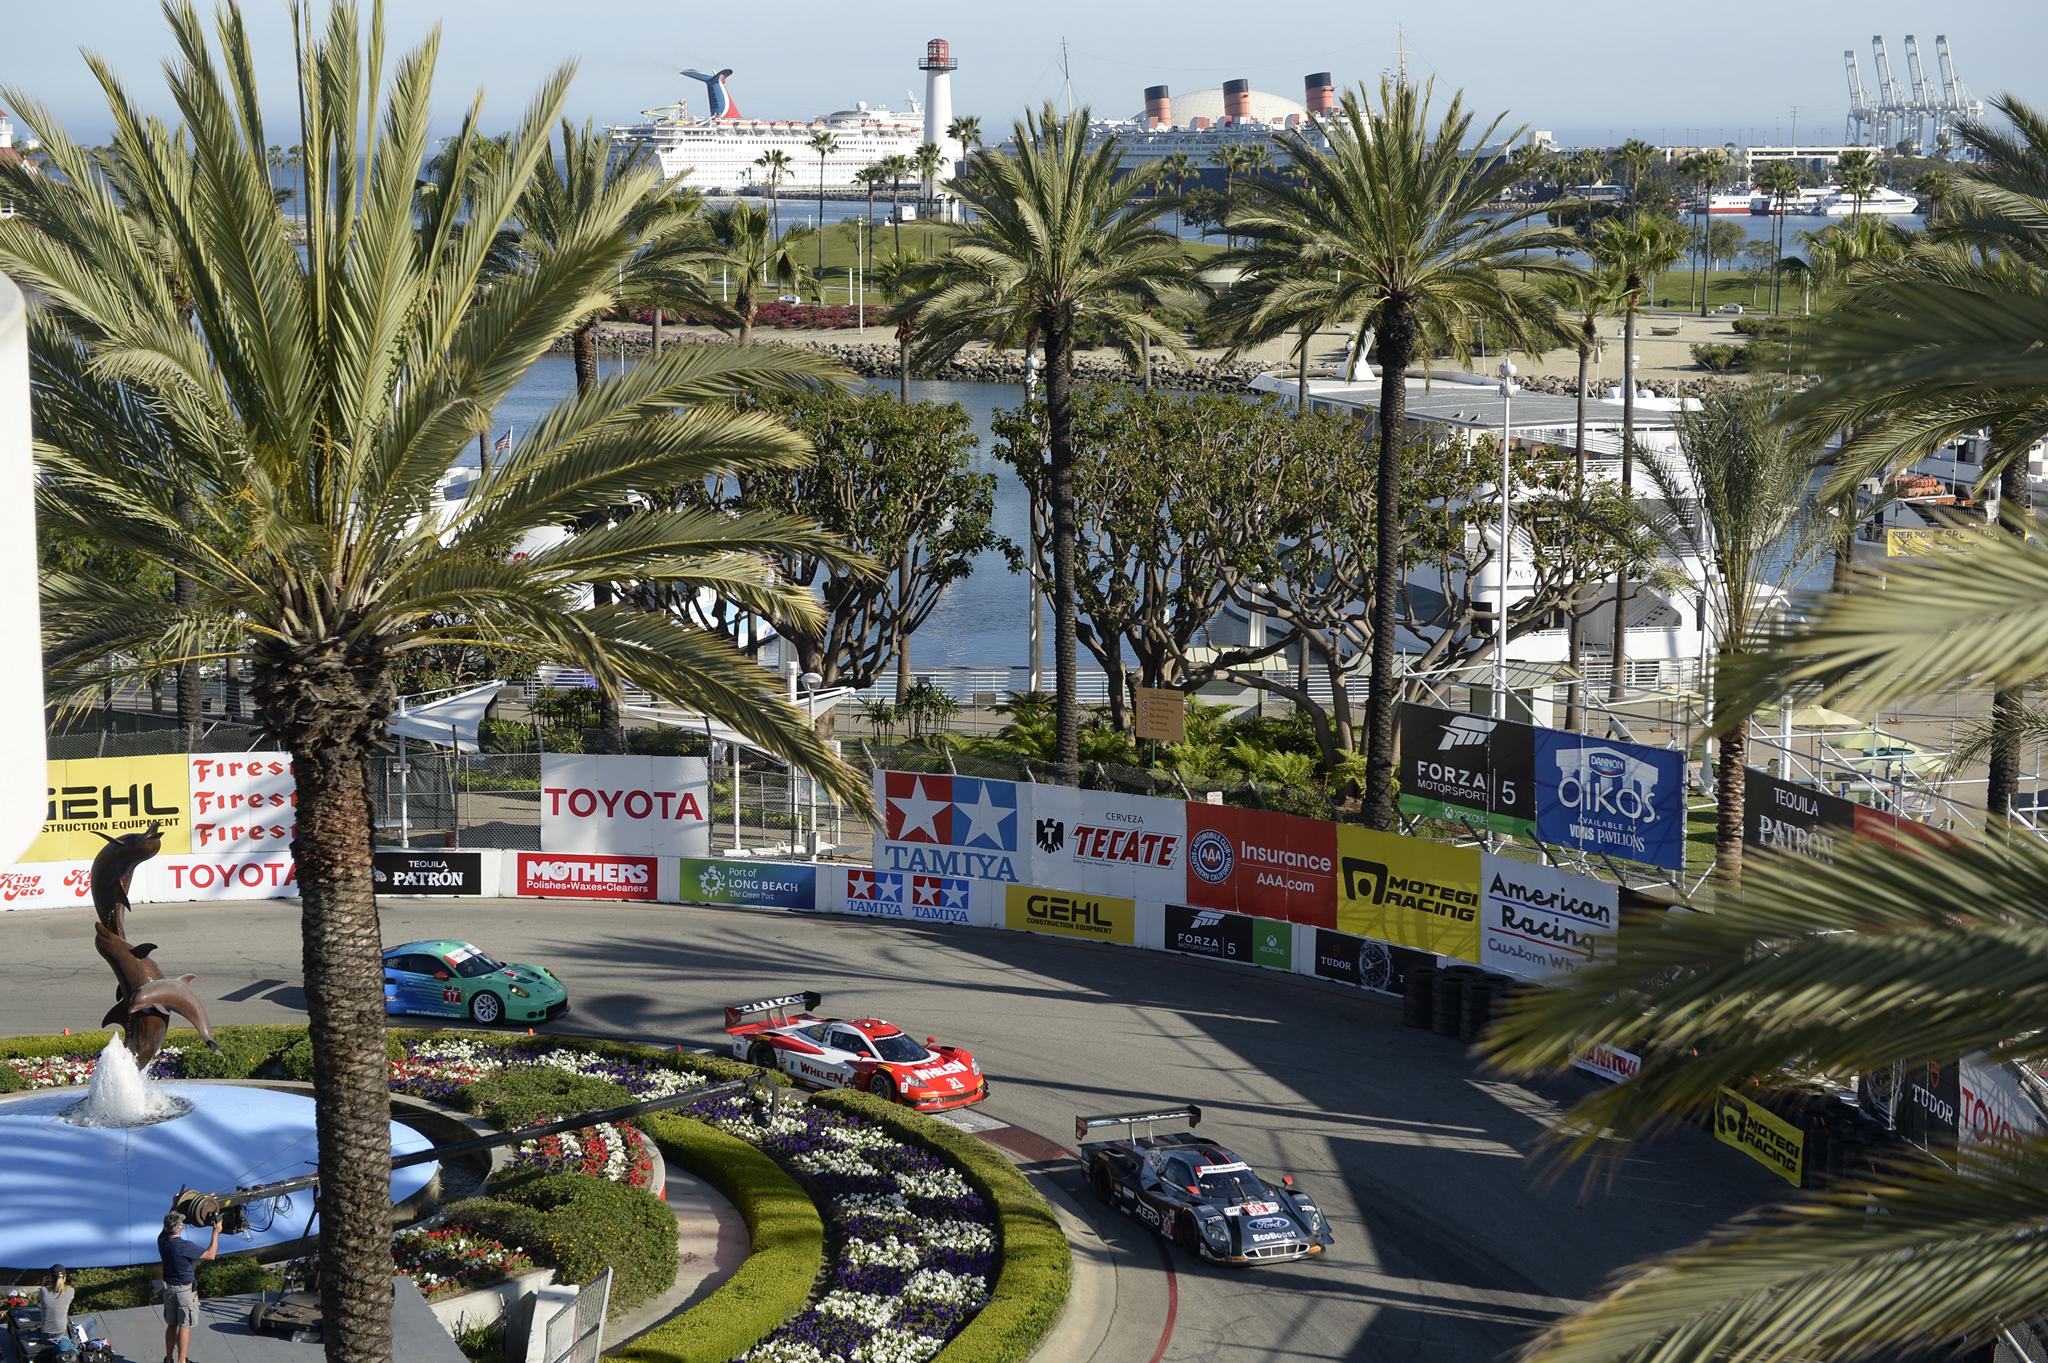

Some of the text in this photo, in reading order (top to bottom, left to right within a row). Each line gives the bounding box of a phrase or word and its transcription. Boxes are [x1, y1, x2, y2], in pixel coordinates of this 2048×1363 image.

[1590, 755, 1624, 770] DANNON
[1417, 760, 1517, 805] FORZA 5
[1417, 779, 1487, 801] MOTORSPORT
[544, 787, 704, 821] TOYOTA
[1558, 776, 1656, 823] OIKOS
[1773, 787, 1819, 817] TEQUILA
[112, 818, 179, 830] EQUIPMENT
[1105, 812, 1144, 824] CERVEZA
[1577, 816, 1624, 831] AVAILABLE
[1071, 824, 1180, 868] TECATE
[1193, 831, 1231, 854] AUTOMOBILE CLUB
[1569, 823, 1645, 852] VONS PAVILIONS
[408, 859, 448, 868] TEQUILA
[885, 845, 1019, 883] TAMIYA
[1191, 851, 1232, 881] SOUTHERN CALIFORNIA
[1202, 848, 1222, 862] AAA
[1241, 840, 1332, 872] Insurance
[0, 873, 42, 889] King
[393, 868, 464, 886] PATRÓN
[526, 860, 648, 884] MOTHERS
[729, 867, 758, 879] Port of
[1256, 872, 1315, 893] AAA.com
[4, 884, 45, 901] Taco
[729, 879, 799, 893] LONG BEACH
[729, 890, 775, 900] The Green Port
[1389, 875, 1479, 907] MOTEGI
[847, 900, 904, 916] TAMIYA
[1385, 891, 1475, 921] RACING
[1489, 872, 1610, 923] American
[912, 906, 969, 922] TAMIYA
[1027, 895, 1113, 927] GEHL
[1026, 917, 1113, 935] CONSTRUCTION EQUIPMENT
[1502, 904, 1595, 962] Racing
[1178, 933, 1236, 955] FORZA 5
[1178, 942, 1219, 953] MOTORSPORT
[1488, 937, 1546, 966] Custom
[1320, 956, 1352, 971] TUDOR
[446, 992, 458, 1002] 17
[800, 1062, 844, 1085] WHELEN
[912, 1059, 969, 1081] WHELEN
[1912, 1083, 1954, 1126] TUDOR
[1747, 1116, 1800, 1159] MOTEGI
[1744, 1131, 1797, 1173] RACING
[1135, 1204, 1160, 1226] AERO
[1256, 1219, 1281, 1229] Ford
[1252, 1230, 1297, 1242] EcoBoost
